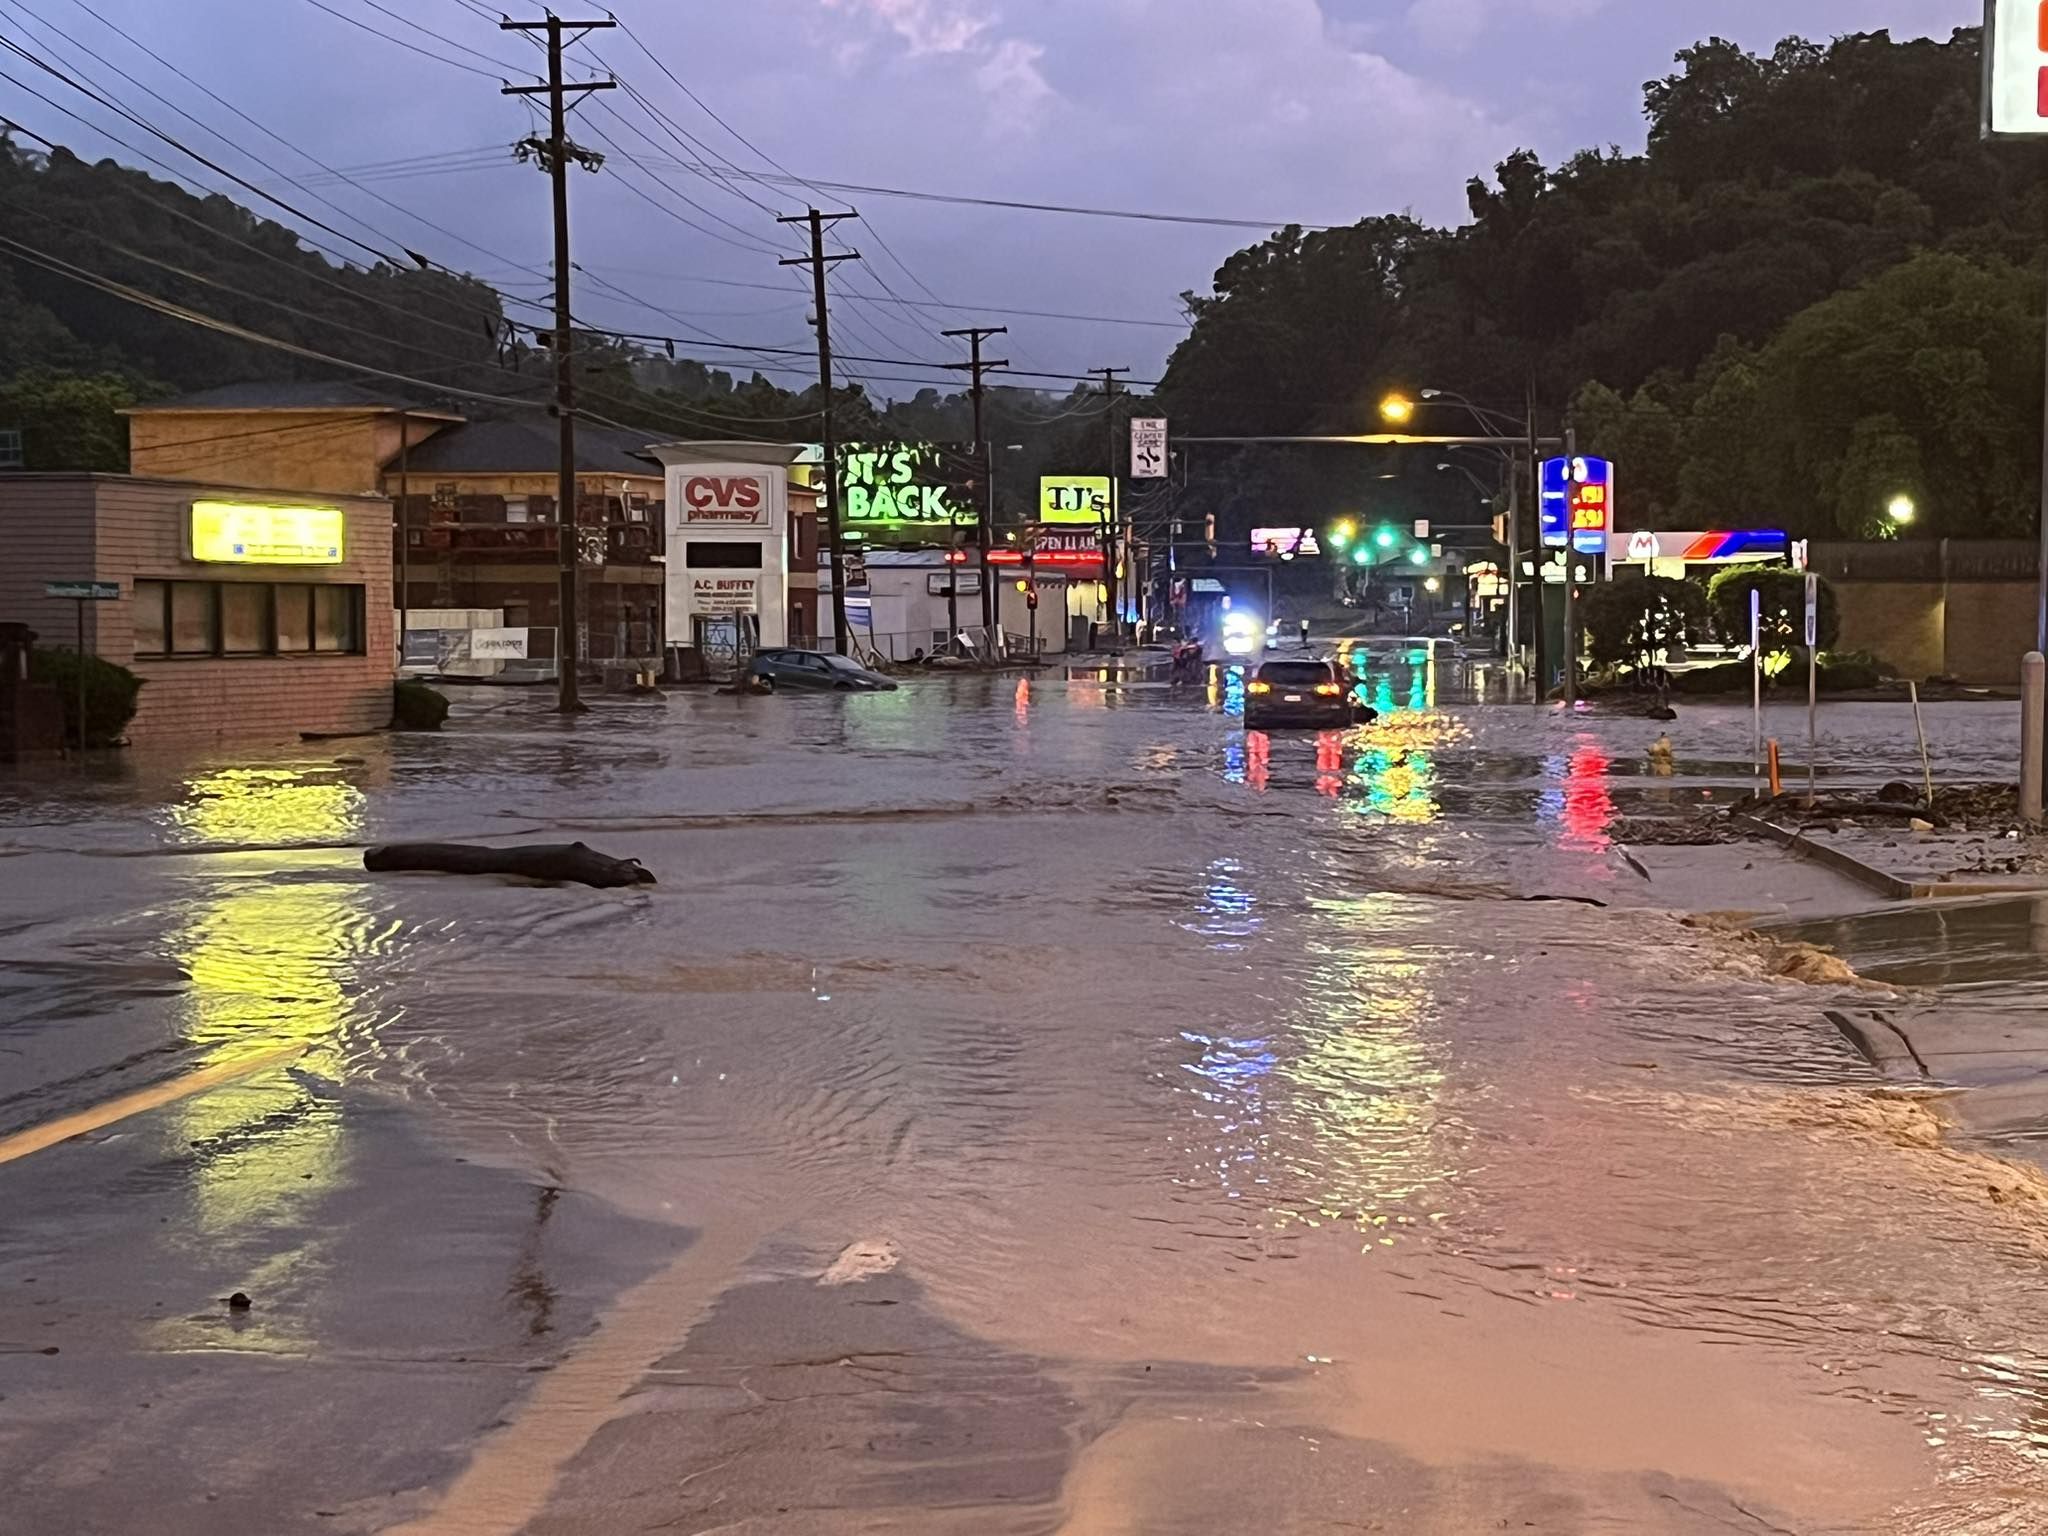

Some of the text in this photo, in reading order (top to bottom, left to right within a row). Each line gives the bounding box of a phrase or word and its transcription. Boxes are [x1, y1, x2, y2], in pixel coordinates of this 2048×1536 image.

[844, 452, 913, 487] IT'S
[685, 476, 760, 508] CVS
[1047, 487, 1105, 512] TJ's
[687, 507, 761, 524] pharmacy
[694, 580, 754, 590] A.C. BUFFET
